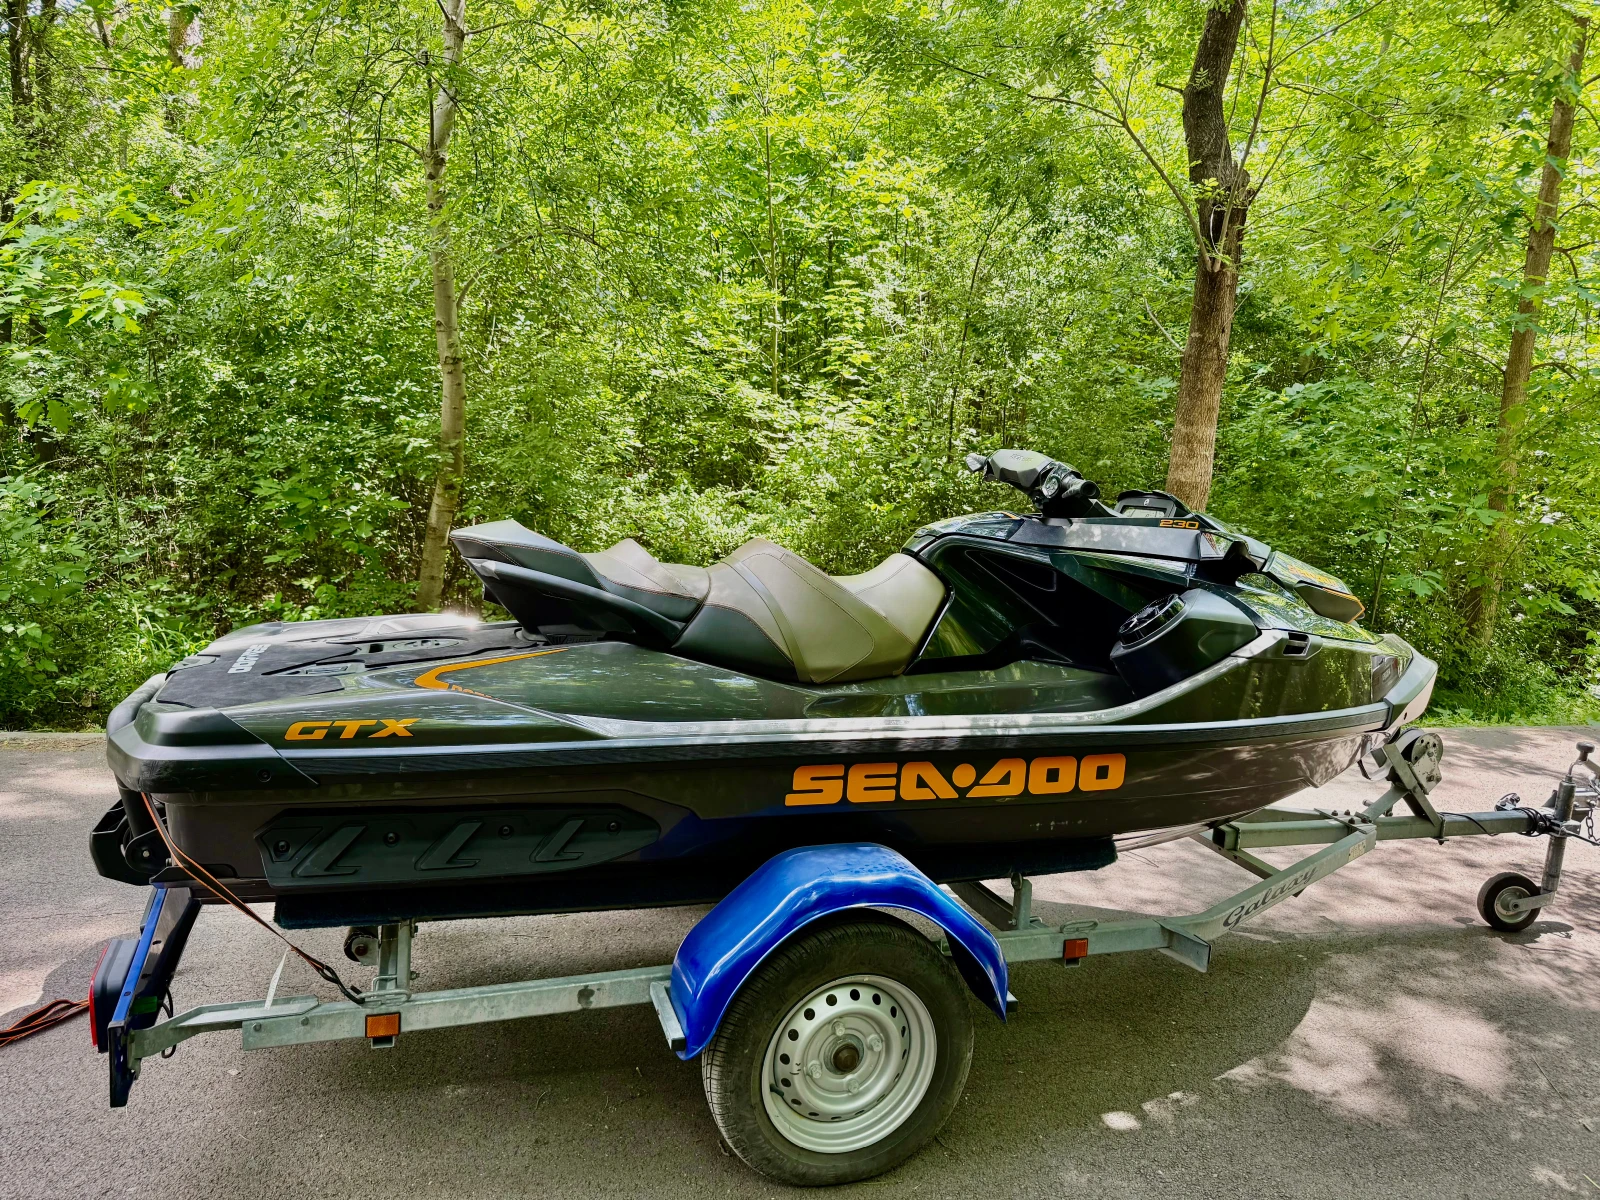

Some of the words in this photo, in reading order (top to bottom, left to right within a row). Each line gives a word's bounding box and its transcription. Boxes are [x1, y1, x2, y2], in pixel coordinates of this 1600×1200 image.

[1160, 519, 1199, 530] 230
[284, 717, 422, 741] GTX
[1222, 866, 1317, 932] Galaxy
